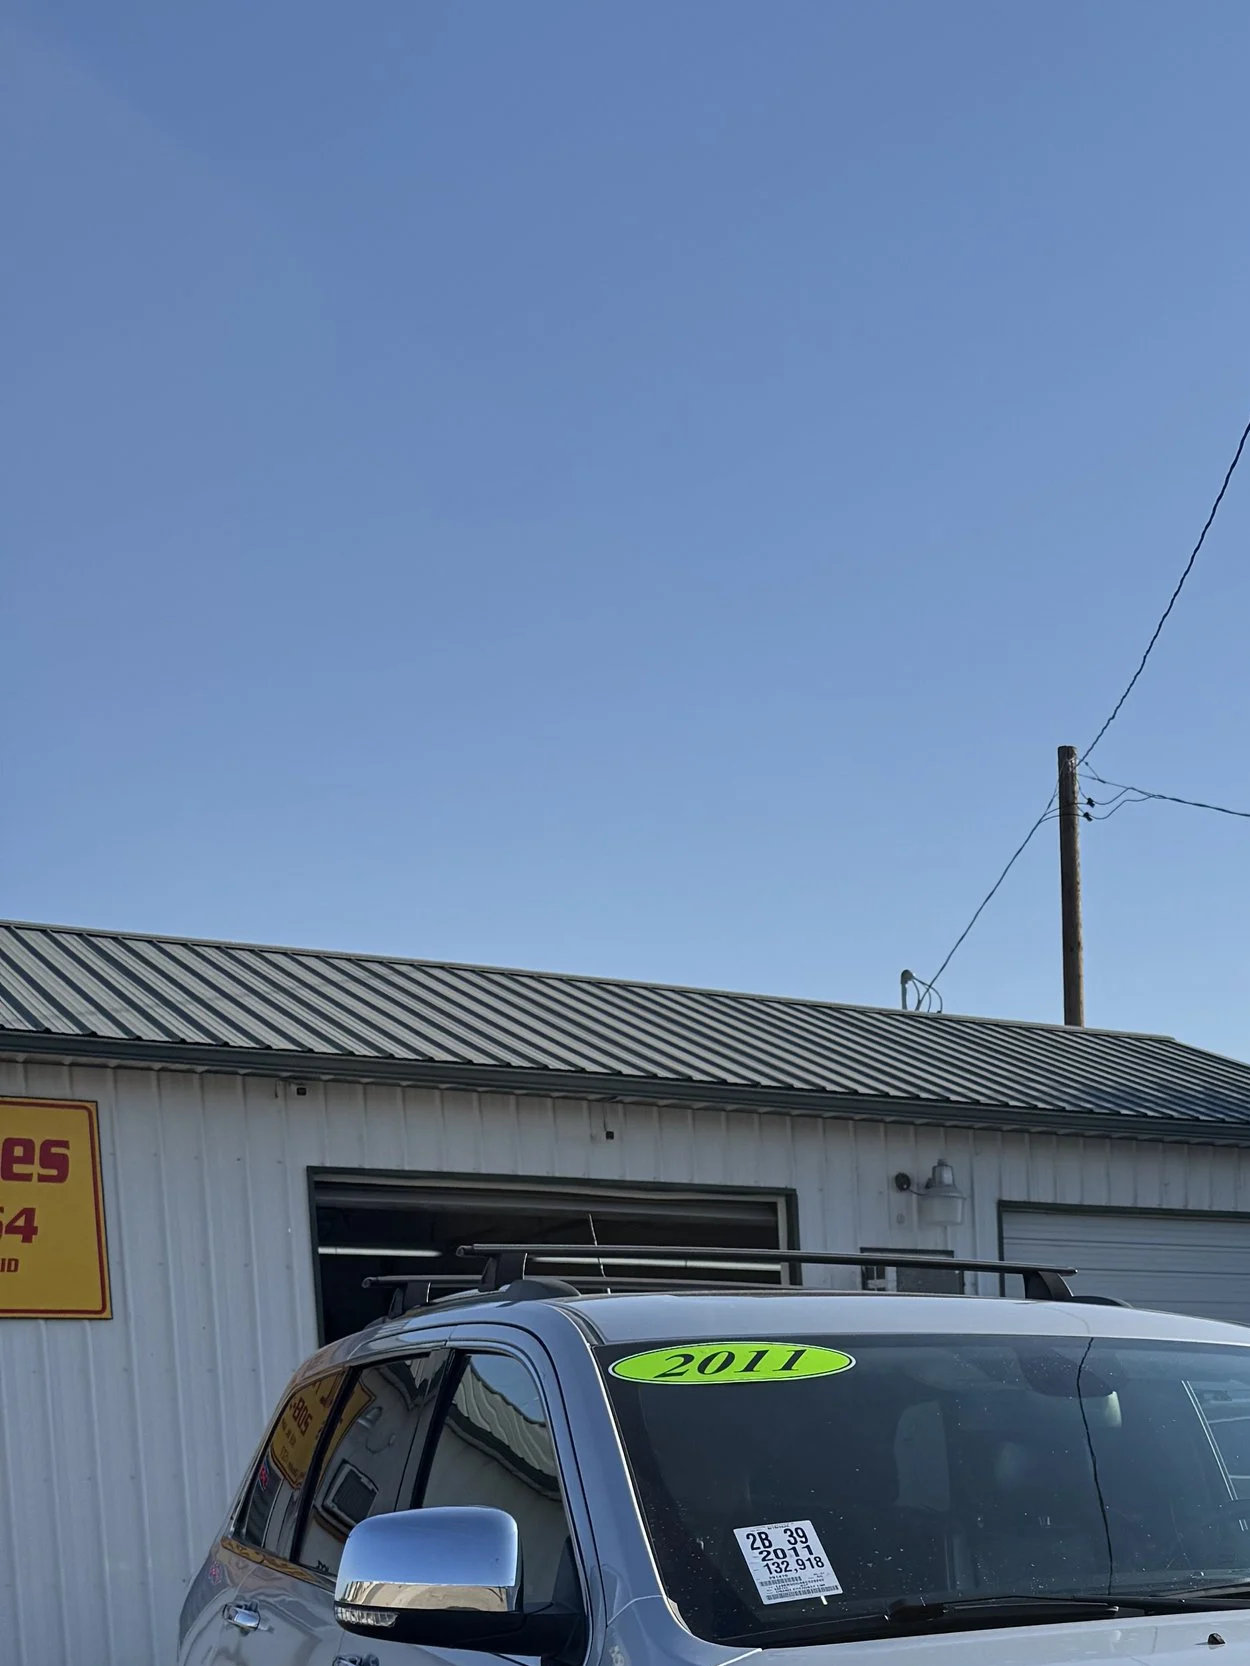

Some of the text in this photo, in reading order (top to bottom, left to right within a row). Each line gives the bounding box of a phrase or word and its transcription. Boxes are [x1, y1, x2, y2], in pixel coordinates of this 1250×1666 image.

[653, 1349, 807, 1379] 2011
[745, 1526, 809, 1551] 2B 39
[758, 1544, 814, 1562] 2011
[763, 1556, 825, 1575] 132,918
